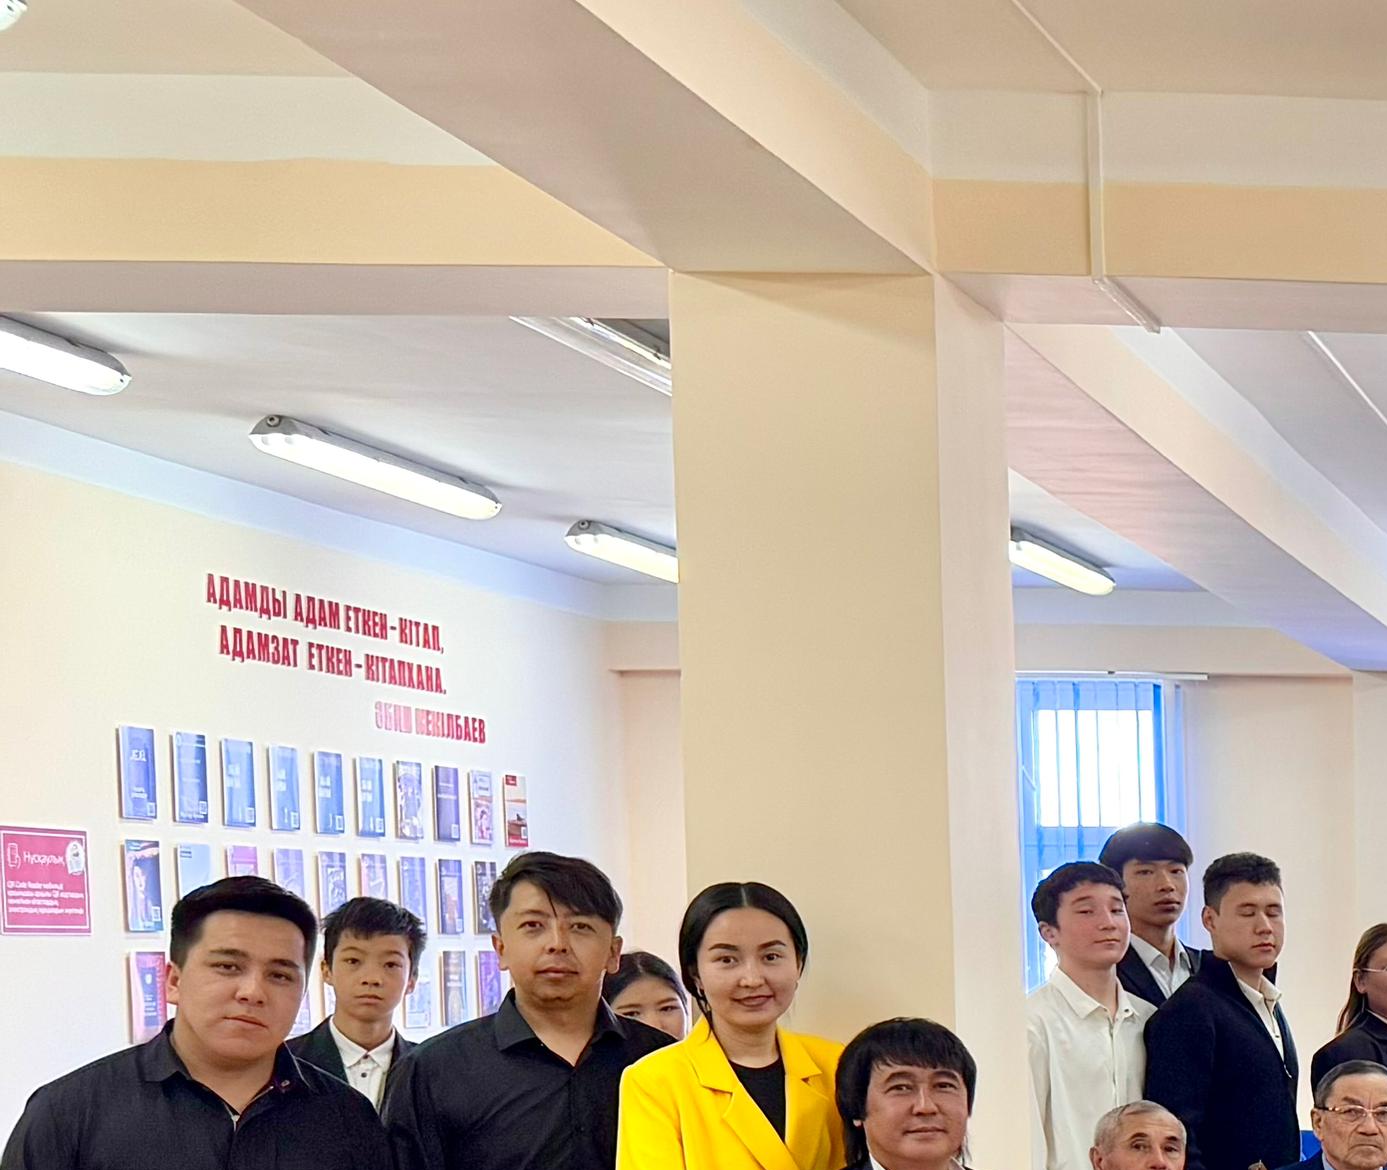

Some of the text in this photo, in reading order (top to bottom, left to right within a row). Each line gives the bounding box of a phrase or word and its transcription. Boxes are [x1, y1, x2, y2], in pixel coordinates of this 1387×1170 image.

[206, 573, 288, 620] АДАМДЫ
[293, 593, 341, 630] АДАМ
[219, 624, 299, 668] АДАМЗАТ
